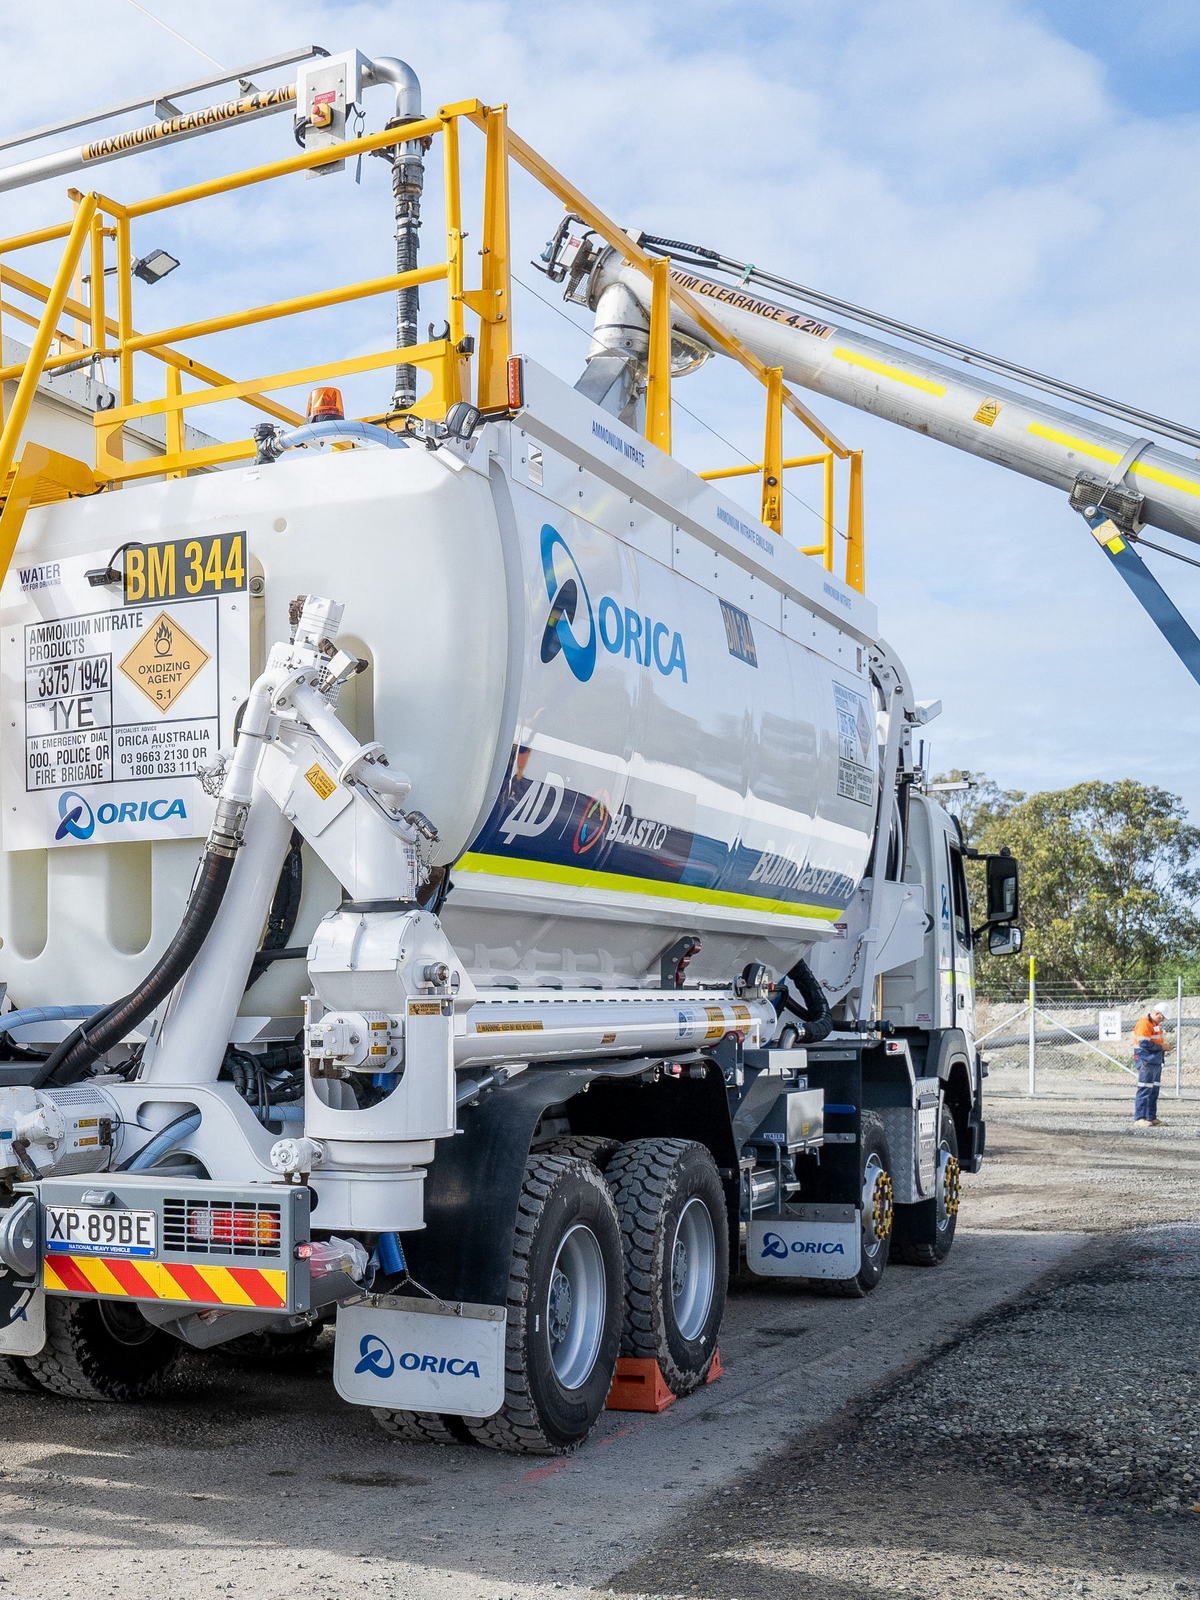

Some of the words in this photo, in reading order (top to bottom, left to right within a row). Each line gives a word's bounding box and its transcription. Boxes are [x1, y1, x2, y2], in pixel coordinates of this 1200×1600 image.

[88, 127, 156, 158] MAXIMUM
[161, 101, 245, 135] CLEARANCE
[249, 86, 290, 109] 4.2M
[700, 282, 782, 321] CLEARANCE
[785, 314, 827, 337] 4.2M
[592, 420, 623, 454] AMMONIUM
[624, 441, 644, 468] NITRATE
[20, 564, 60, 585] WATER
[126, 544, 176, 601] BM
[184, 536, 245, 594] 344
[30, 620, 91, 645] AMMONIUM
[94, 611, 143, 634] NITRATE
[30, 638, 85, 661] PRODUCTS
[598, 596, 688, 684] ORICA
[138, 661, 191, 675] OXIDIZING
[147, 673, 183, 685] AGENT
[156, 689, 171, 700] 5.1
[49, 696, 94, 731] 1YE
[31, 741, 38, 750] IN
[42, 735, 87, 749] EMERGENCY
[91, 732, 108, 743] DIAL
[118, 734, 149, 747] ORICA
[152, 729, 210, 744] AUSTRALIA
[56, 746, 90, 765] POLICE
[96, 745, 109, 761] OR
[121, 753, 133, 764] 03
[136, 750, 161, 762] 9663
[164, 748, 189, 760] 2130
[192, 747, 207, 758] OR
[35, 769, 56, 785] FIRE
[61, 763, 103, 782] BRIGADE
[130, 764, 154, 775] 1800
[157, 762, 176, 773] 033
[180, 761, 197, 772] 111
[96, 798, 187, 824] ORICA
[791, 1241, 845, 1255] ORICA
[399, 1352, 480, 1378] ORICA
